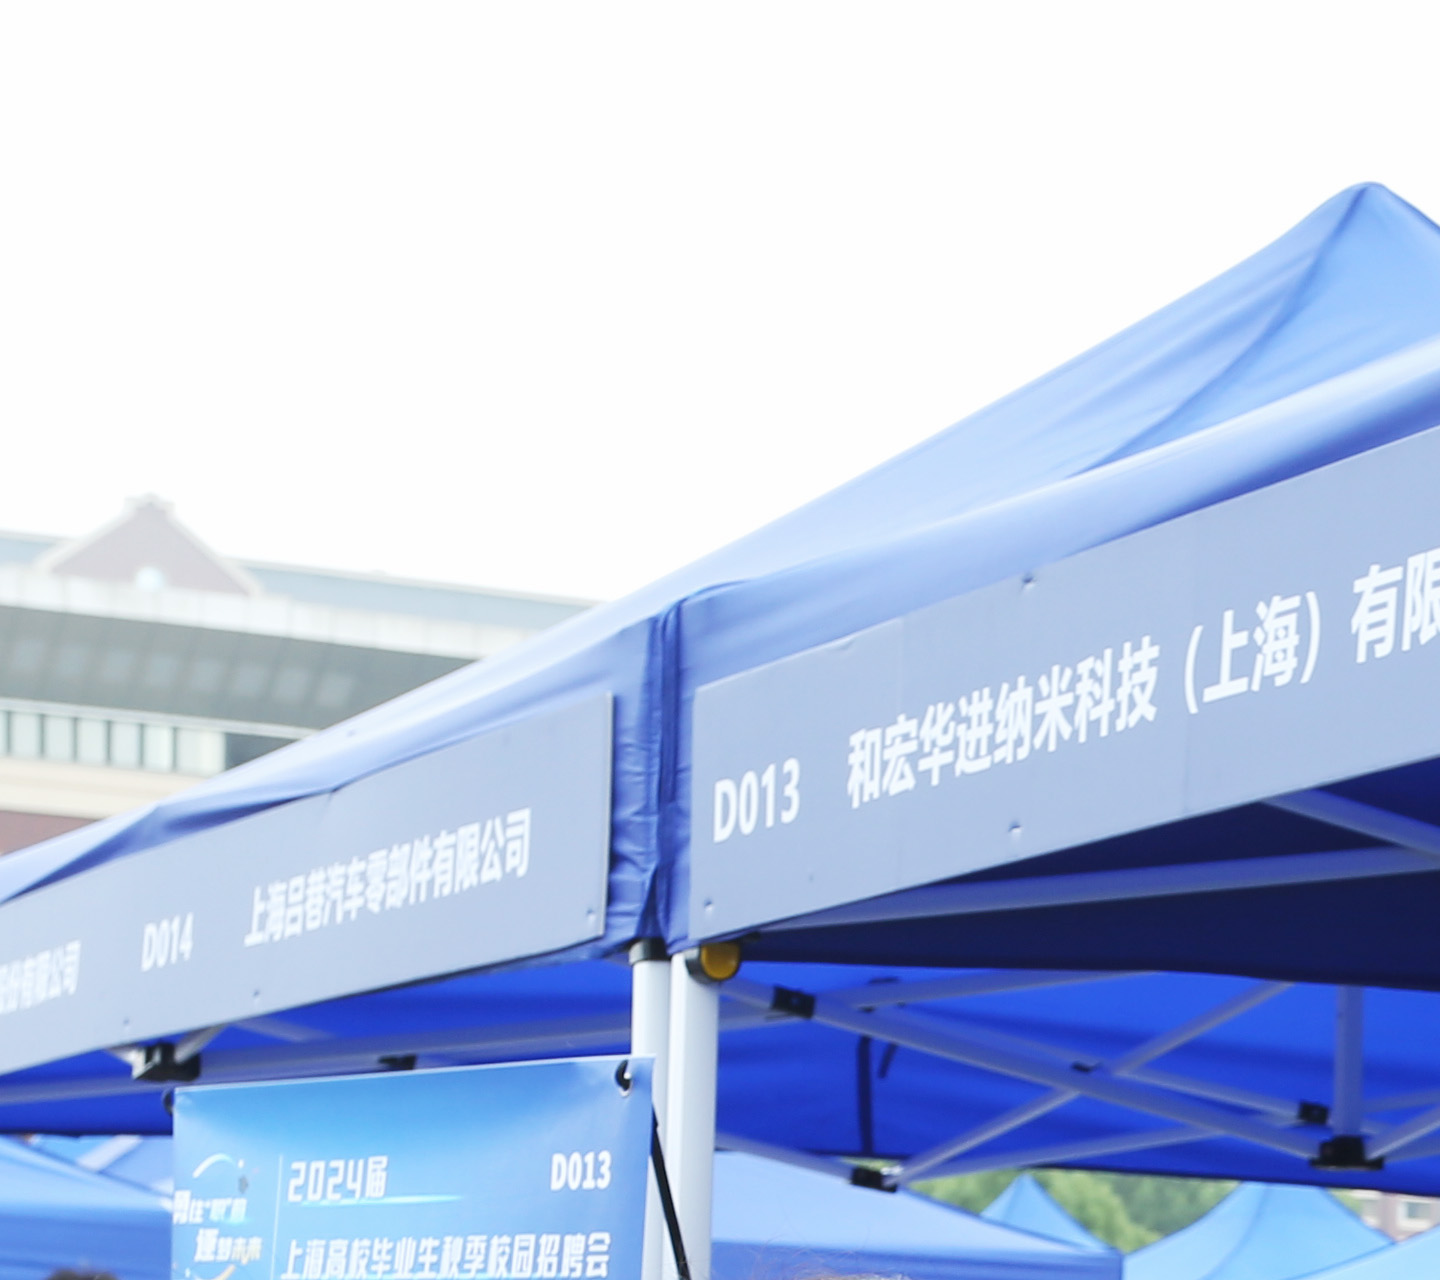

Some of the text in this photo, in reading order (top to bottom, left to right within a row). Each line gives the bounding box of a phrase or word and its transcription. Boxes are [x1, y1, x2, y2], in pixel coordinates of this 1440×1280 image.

[712, 756, 801, 845] D013
[141, 913, 194, 972] D014
[287, 1149, 612, 1203] 2024届 D013
